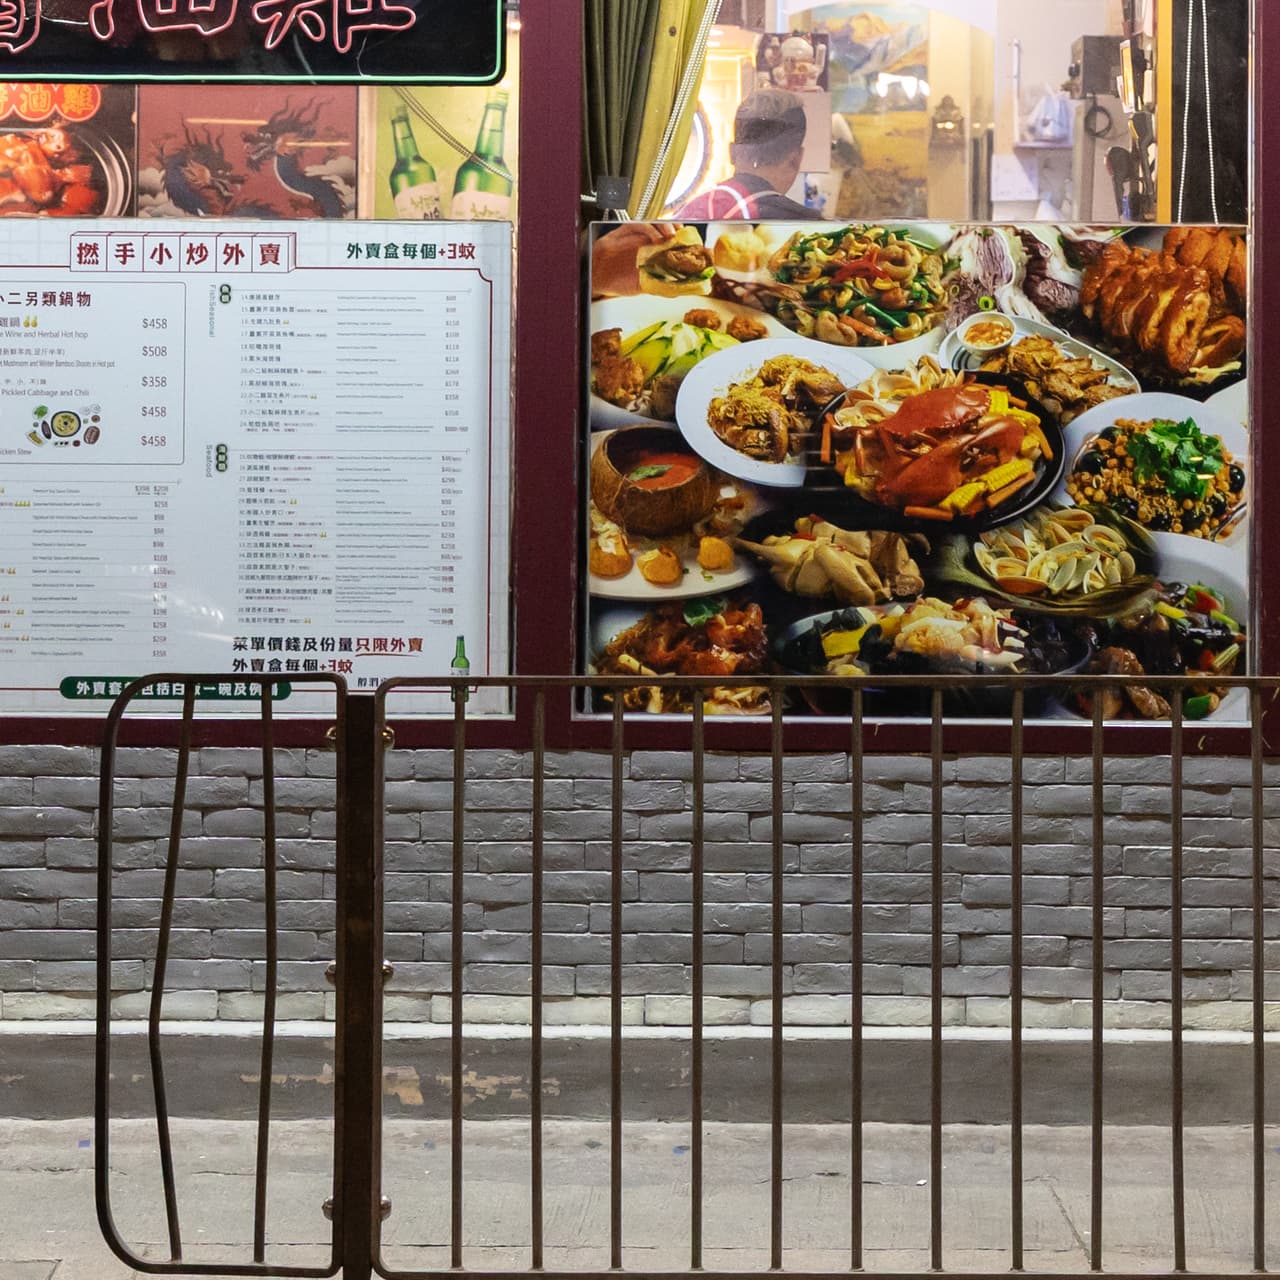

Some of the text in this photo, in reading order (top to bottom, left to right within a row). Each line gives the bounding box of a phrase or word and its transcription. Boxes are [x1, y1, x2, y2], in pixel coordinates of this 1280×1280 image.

[142, 318, 168, 330] $458
[142, 346, 168, 357] $508
[141, 376, 168, 388] $358
[141, 406, 167, 418] $458
[141, 435, 167, 447] $458
[232, 636, 424, 652] 菜單價錢及份量只限外賣
